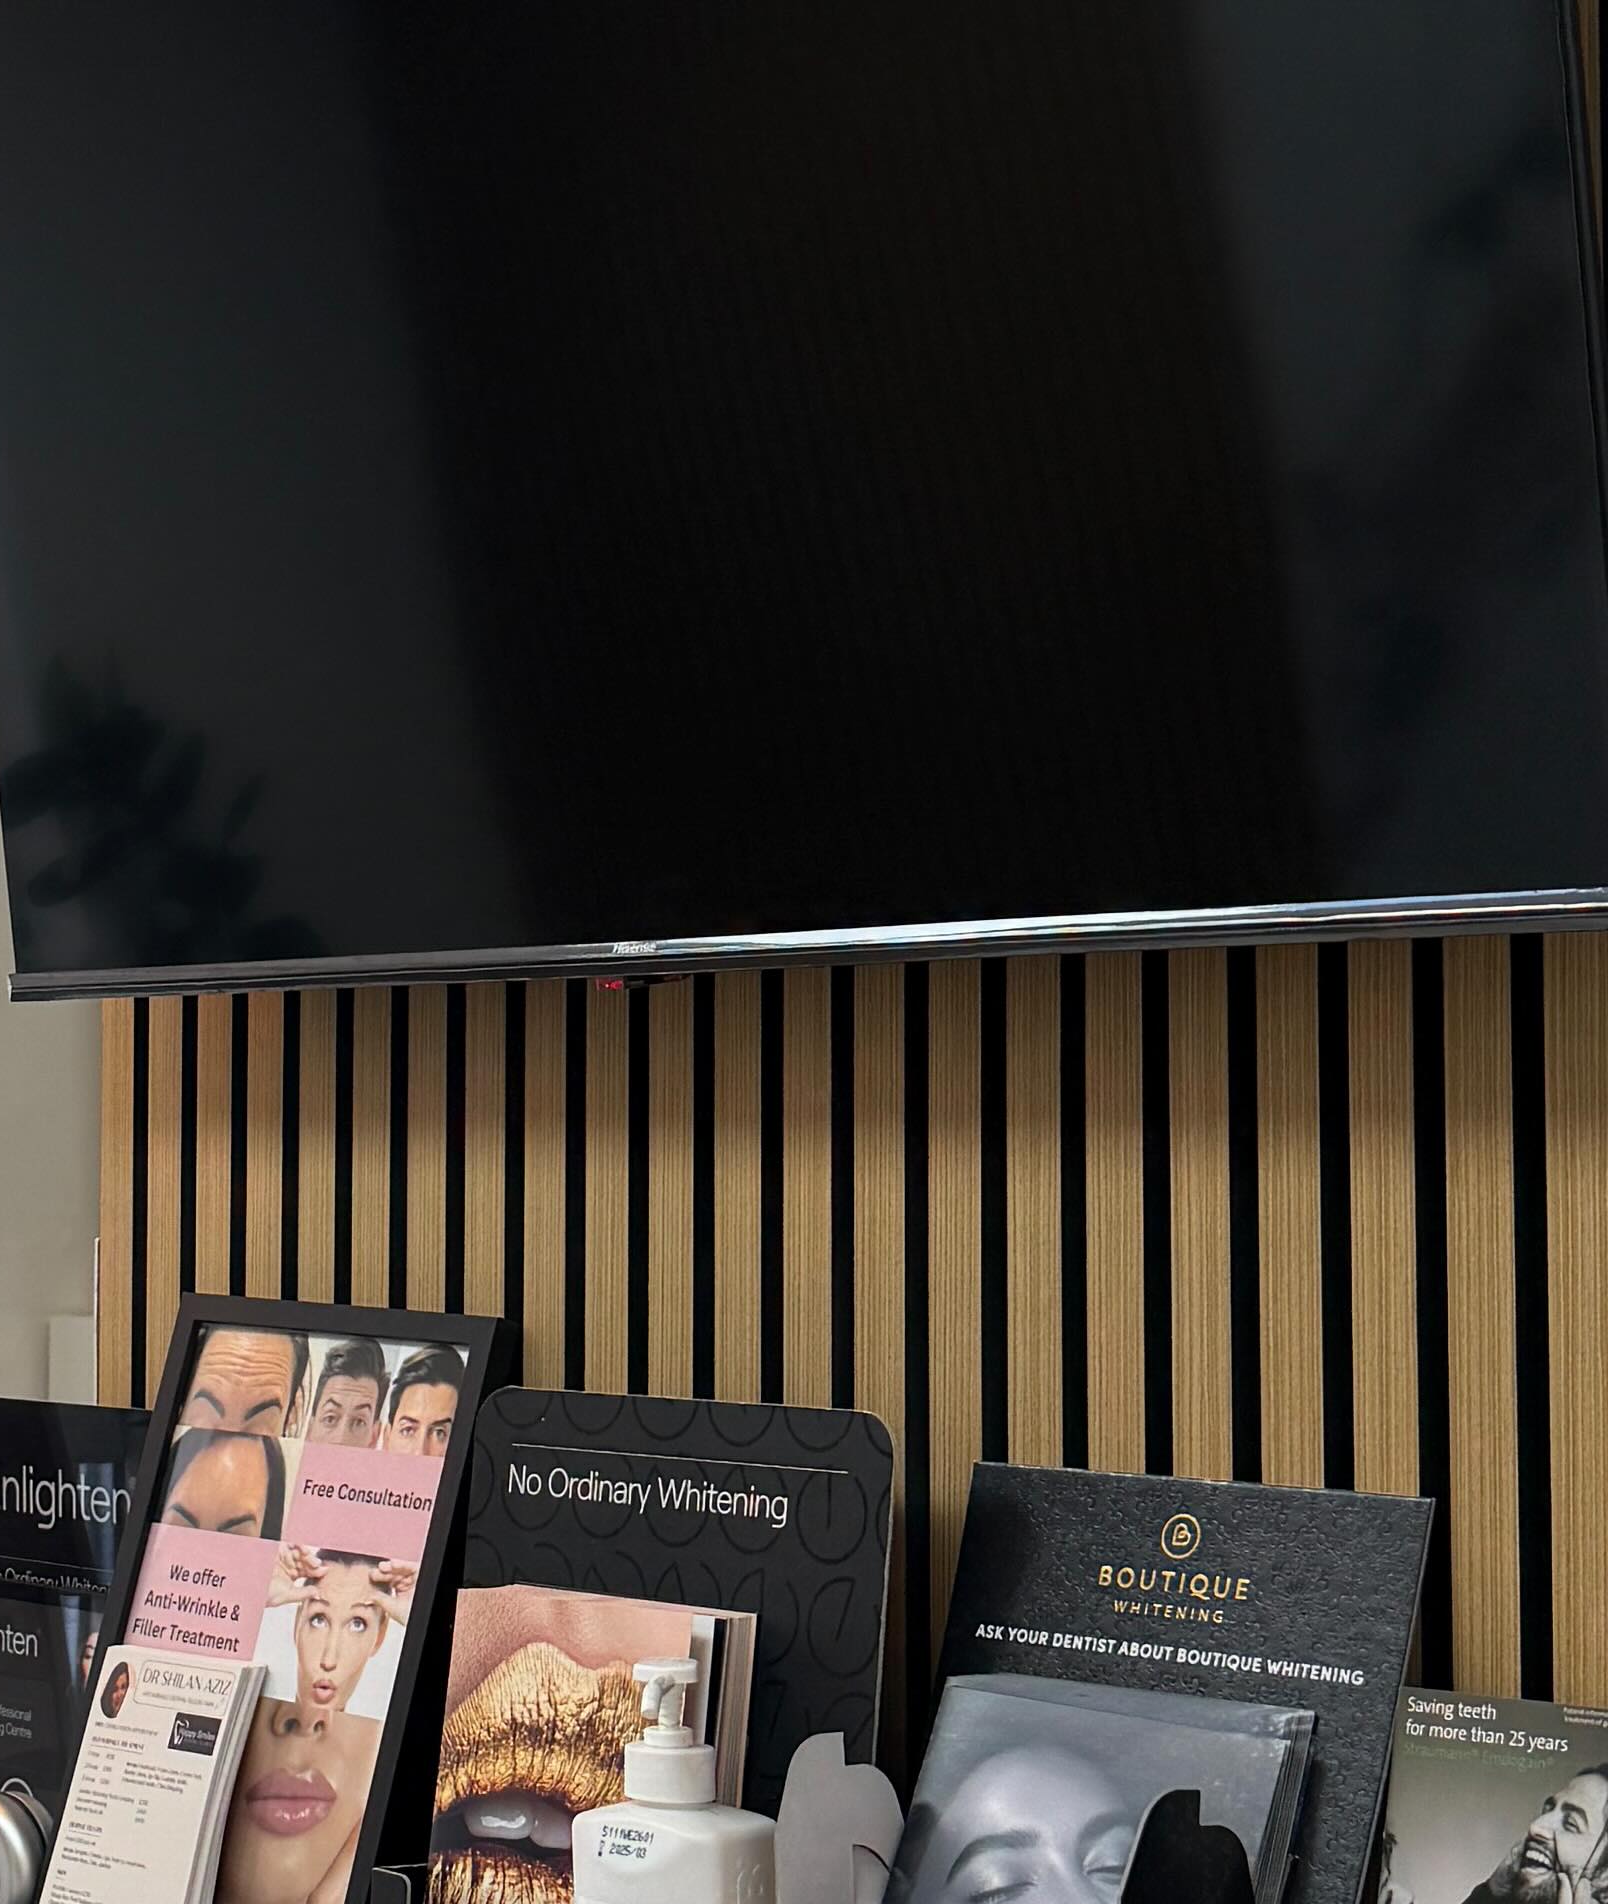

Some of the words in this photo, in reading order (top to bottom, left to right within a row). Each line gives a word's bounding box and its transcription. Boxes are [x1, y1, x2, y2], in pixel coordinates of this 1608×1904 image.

[303, 1479, 335, 1499] Free
[337, 1483, 432, 1512] Consultation
[508, 1463, 542, 1495] No
[548, 1467, 651, 1514] Ordinary
[658, 1476, 788, 1528] Whitening
[169, 1564, 190, 1583] We
[192, 1567, 226, 1589] offer
[1097, 1565, 1251, 1600] BOUTIQUE
[144, 1589, 228, 1620] Anti-Wrinkle
[230, 1604, 240, 1621] &
[1113, 1600, 1224, 1624] WHITENING
[132, 1618, 167, 1639] Filler
[169, 1624, 240, 1652] Treatment
[976, 1624, 1004, 1641] ASK
[1008, 1626, 1049, 1646] YOUR
[1052, 1633, 1117, 1654] DENTIST
[1117, 1641, 1174, 1662] ABOUT
[1176, 1647, 1262, 1673] BOUTIQUE
[1266, 1659, 1364, 1686] WHITENING
[143, 1668, 160, 1684] DR
[1407, 1696, 1454, 1720] Saving
[1458, 1702, 1497, 1720] teeth
[1405, 1718, 1426, 1735] for
[1428, 1725, 1467, 1741] more
[1471, 1726, 1505, 1744] than
[1509, 1730, 1525, 1747] 25
[1527, 1735, 1569, 1752] years
